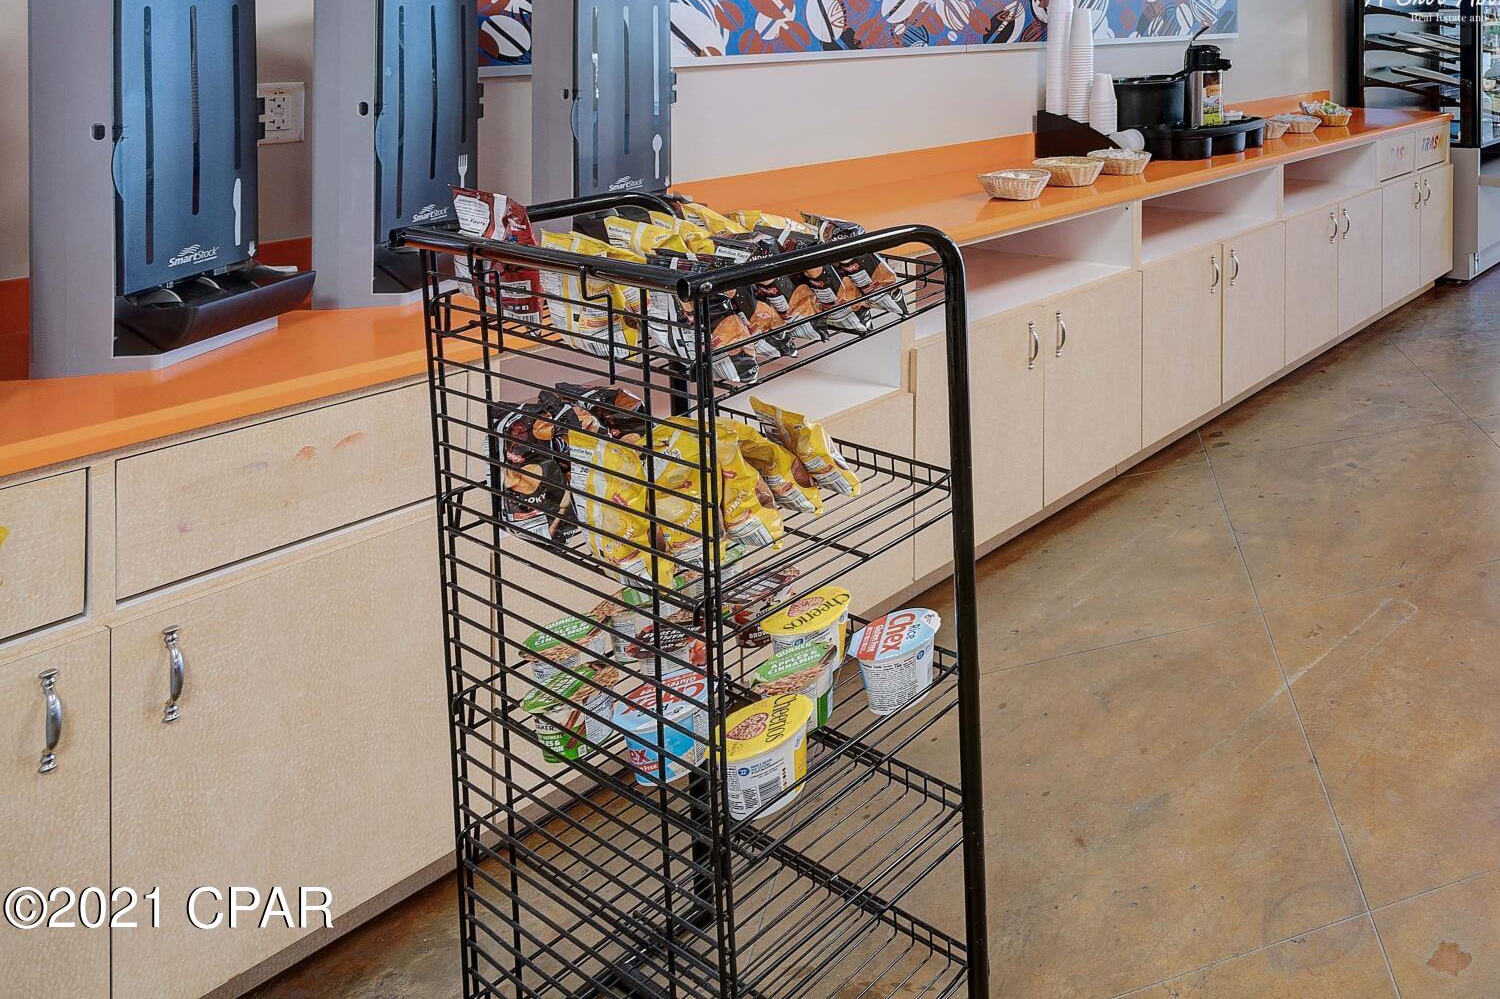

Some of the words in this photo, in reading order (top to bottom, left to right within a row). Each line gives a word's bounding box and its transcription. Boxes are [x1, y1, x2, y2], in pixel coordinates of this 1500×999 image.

[608, 178, 643, 191] SmartStock
[412, 207, 447, 222] SmartStock
[168, 247, 218, 267] SmartStock
[783, 594, 850, 630] Cheerios
[880, 612, 916, 654] Chex
[776, 643, 812, 658] QUAKER
[768, 653, 820, 675] CINNAMON
[771, 653, 809, 669] APPLES
[766, 694, 797, 742] Cheerios
[629, 749, 650, 762] ex
